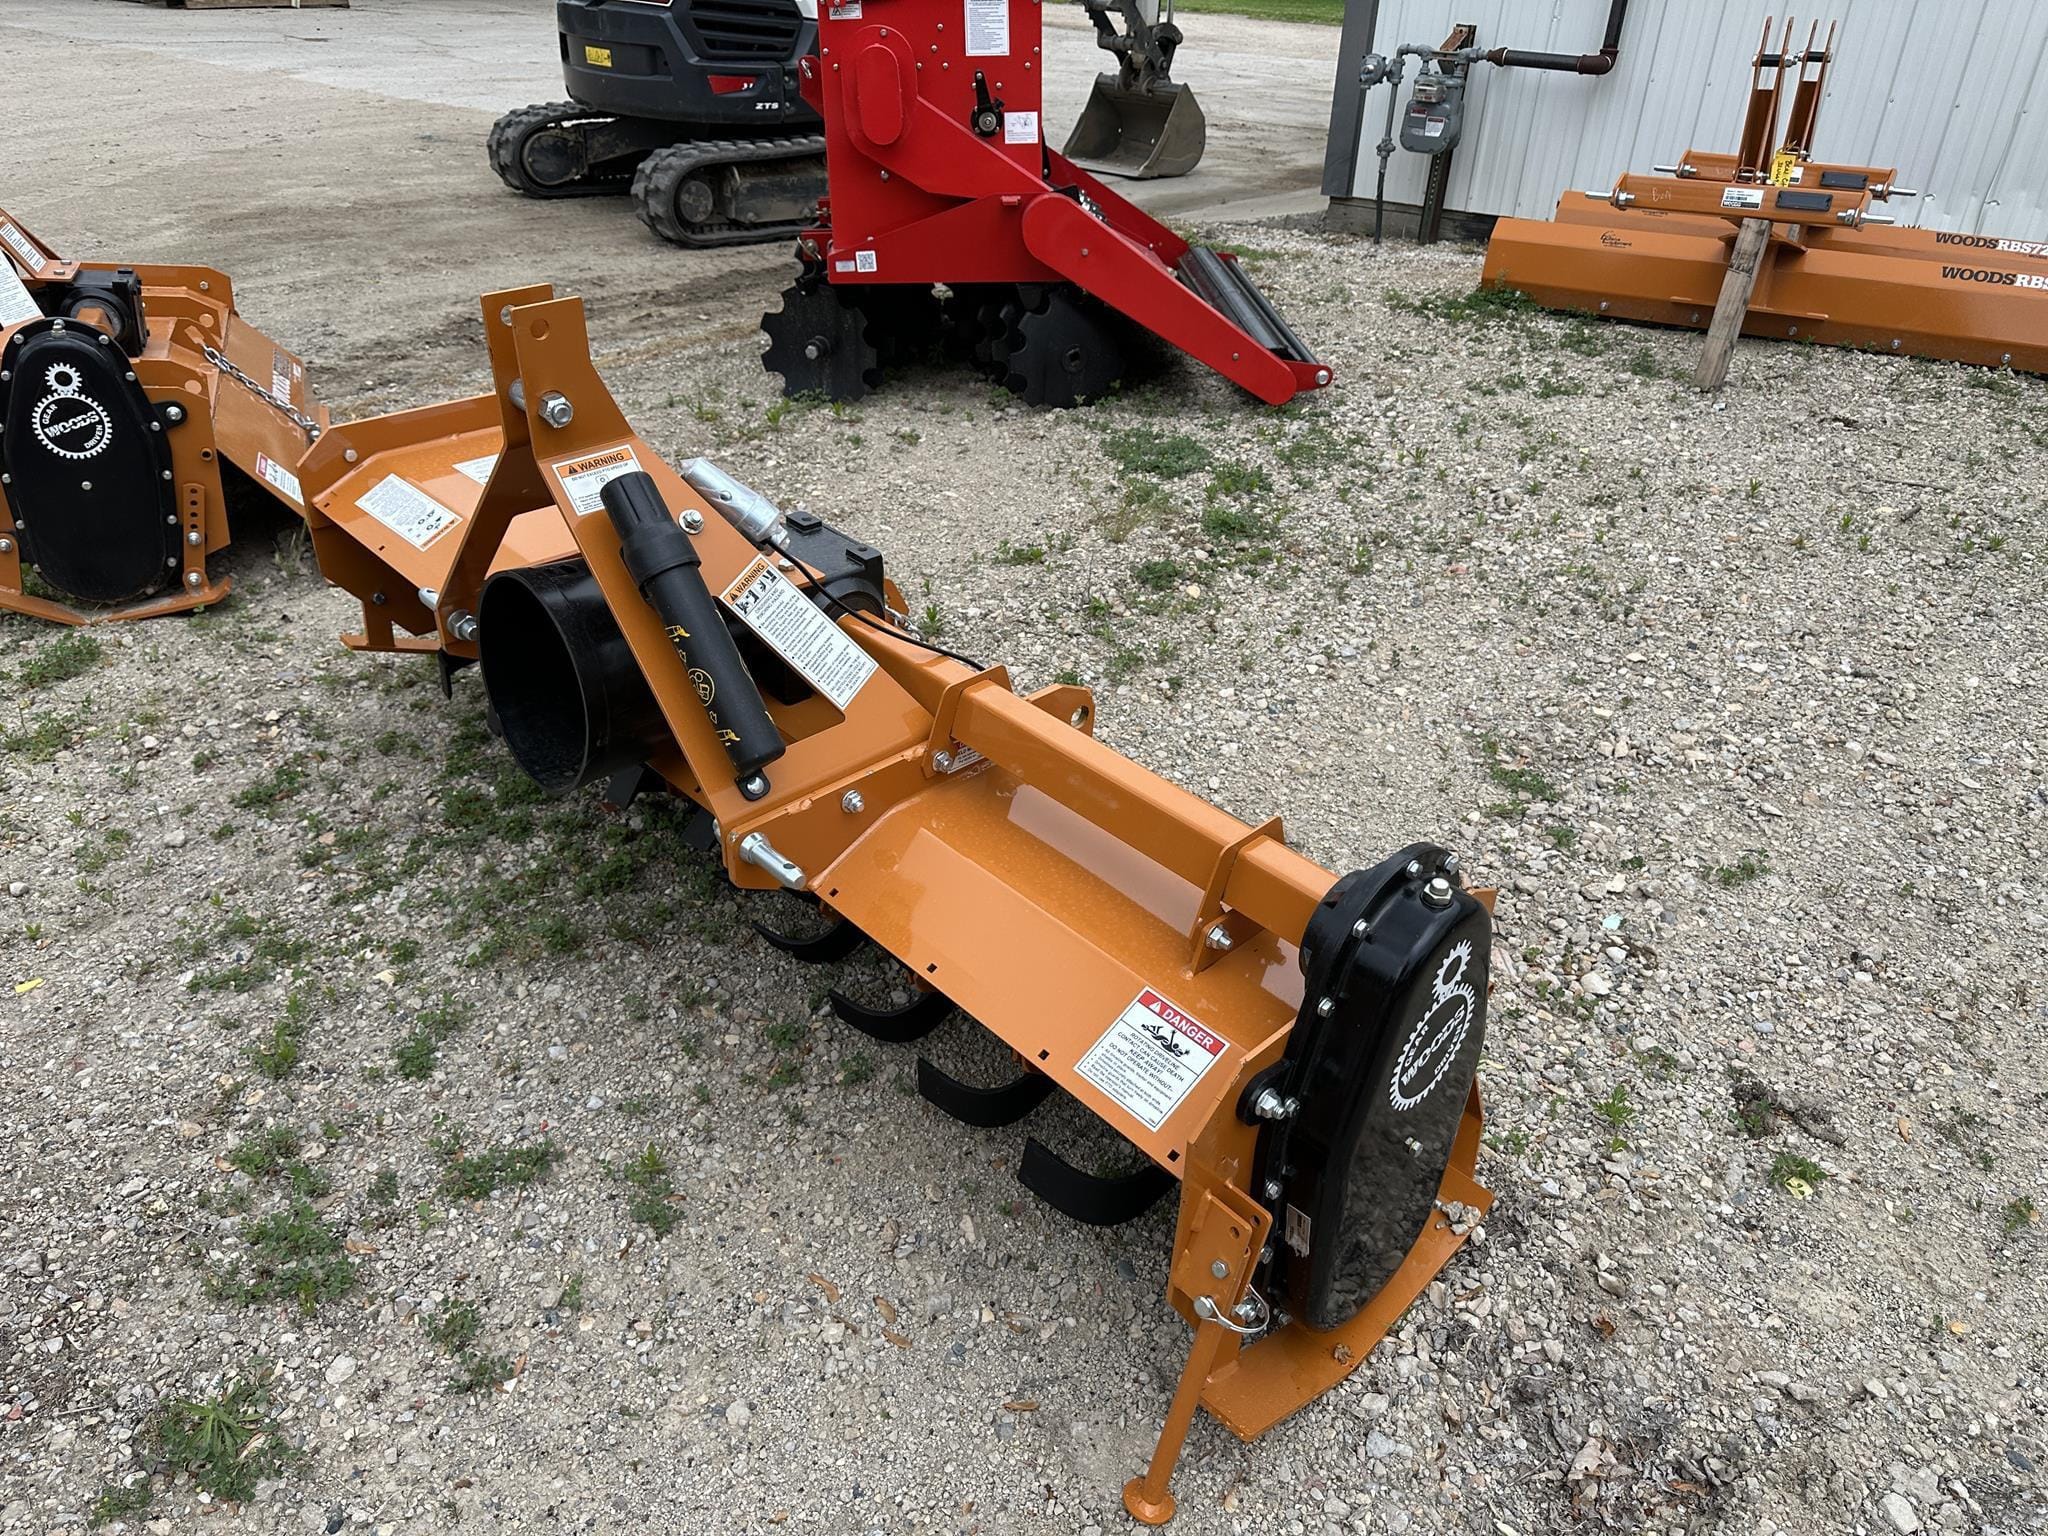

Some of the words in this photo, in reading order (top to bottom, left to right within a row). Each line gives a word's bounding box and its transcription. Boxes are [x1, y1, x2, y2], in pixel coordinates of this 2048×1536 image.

[755, 102, 779, 110] ZTS
[42, 403, 58, 425] GEAR
[44, 410, 100, 438] WOODS
[83, 424, 104, 449] DRIVEN
[577, 452, 625, 471] WARNING
[734, 561, 765, 594] WARNING
[1161, 1008, 1215, 1049] DANGER
[1400, 1004, 1466, 1086] WOODS
[1108, 1041, 1117, 1050] DO
[1115, 1047, 1127, 1057] NOT
[1126, 1055, 1149, 1074] OPERATE
[1116, 1031, 1140, 1050] CONTACT
[1138, 1047, 1151, 1058] CAN
[1149, 1055, 1167, 1069] CAUSE
[1165, 1067, 1184, 1082] DEATH
[1128, 1048, 1145, 1061] KEEP
[1129, 1032, 1155, 1052] ROTATING
[1153, 1049, 1180, 1070] DRIVELINE
[1405, 1024, 1430, 1067] GEAR
[1434, 1023, 1463, 1075] DRIVEN
